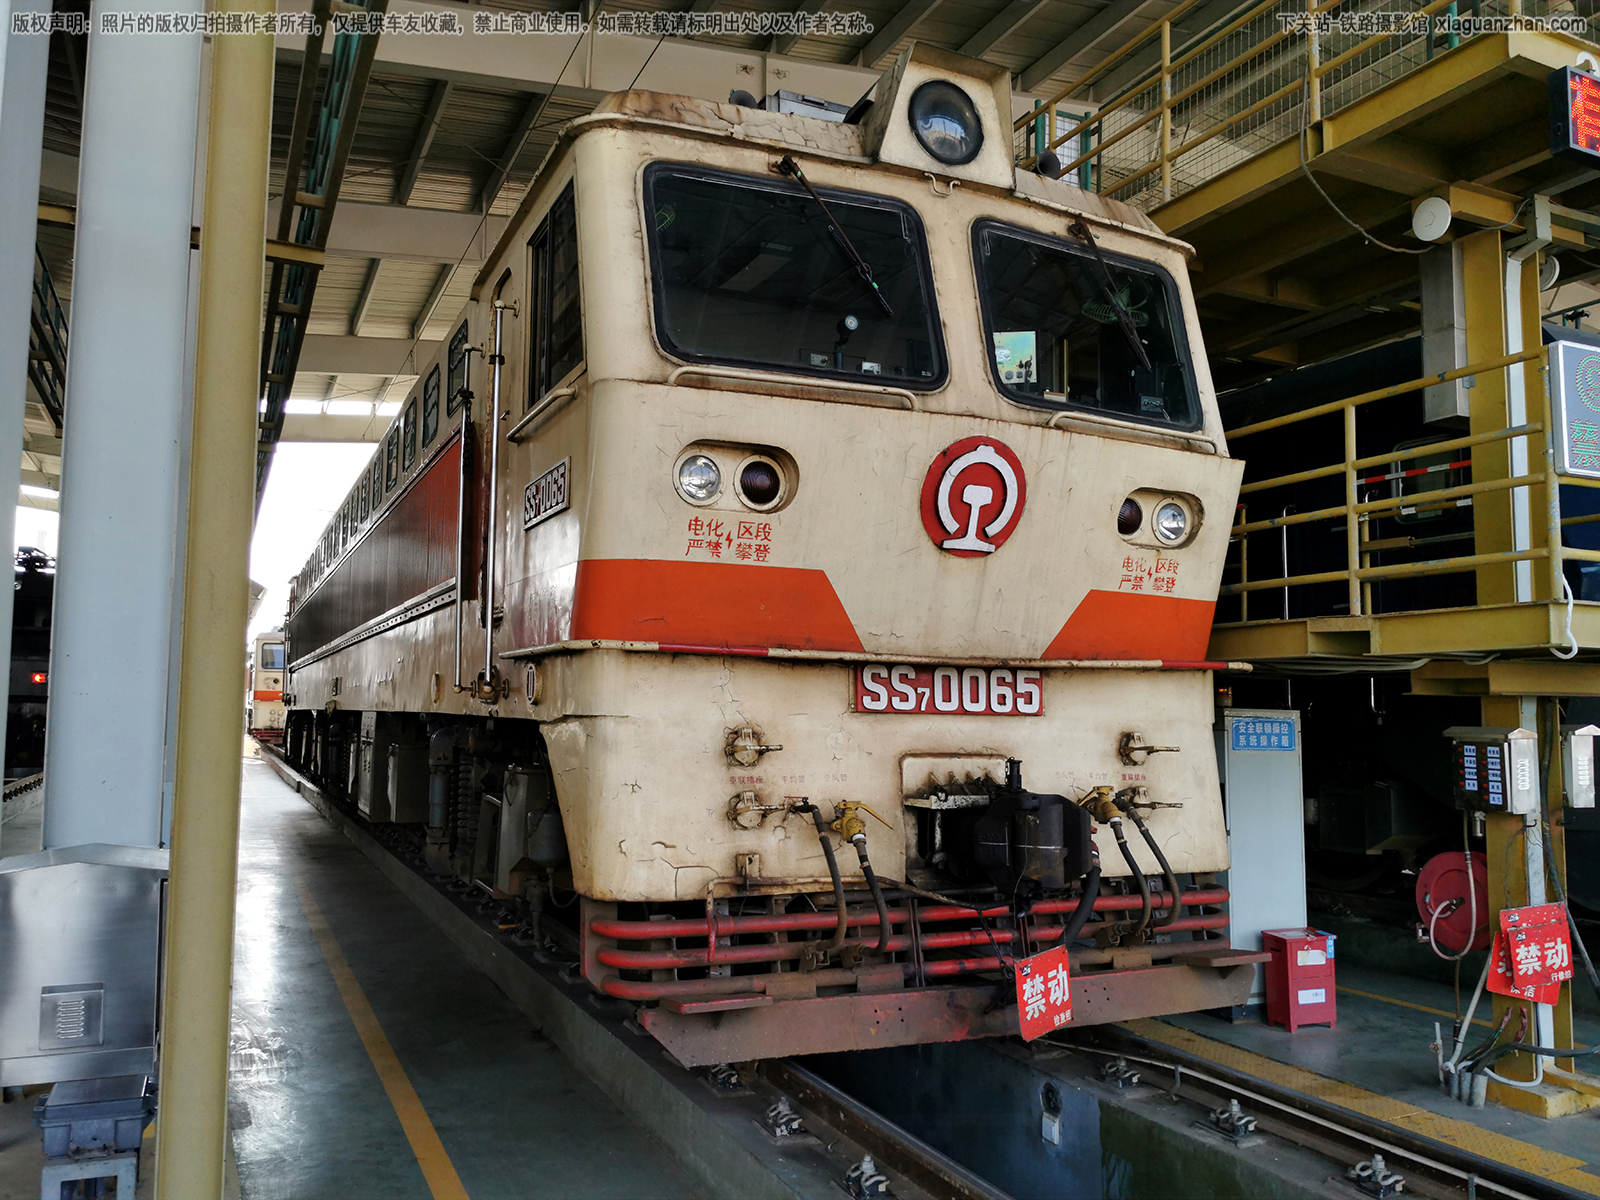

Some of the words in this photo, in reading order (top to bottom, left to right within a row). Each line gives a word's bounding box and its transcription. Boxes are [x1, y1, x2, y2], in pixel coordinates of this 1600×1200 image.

[1239, 735, 1289, 746] 系统操作箱
[1516, 937, 1569, 976] 禁动
[1022, 963, 1070, 1021] 禁动
